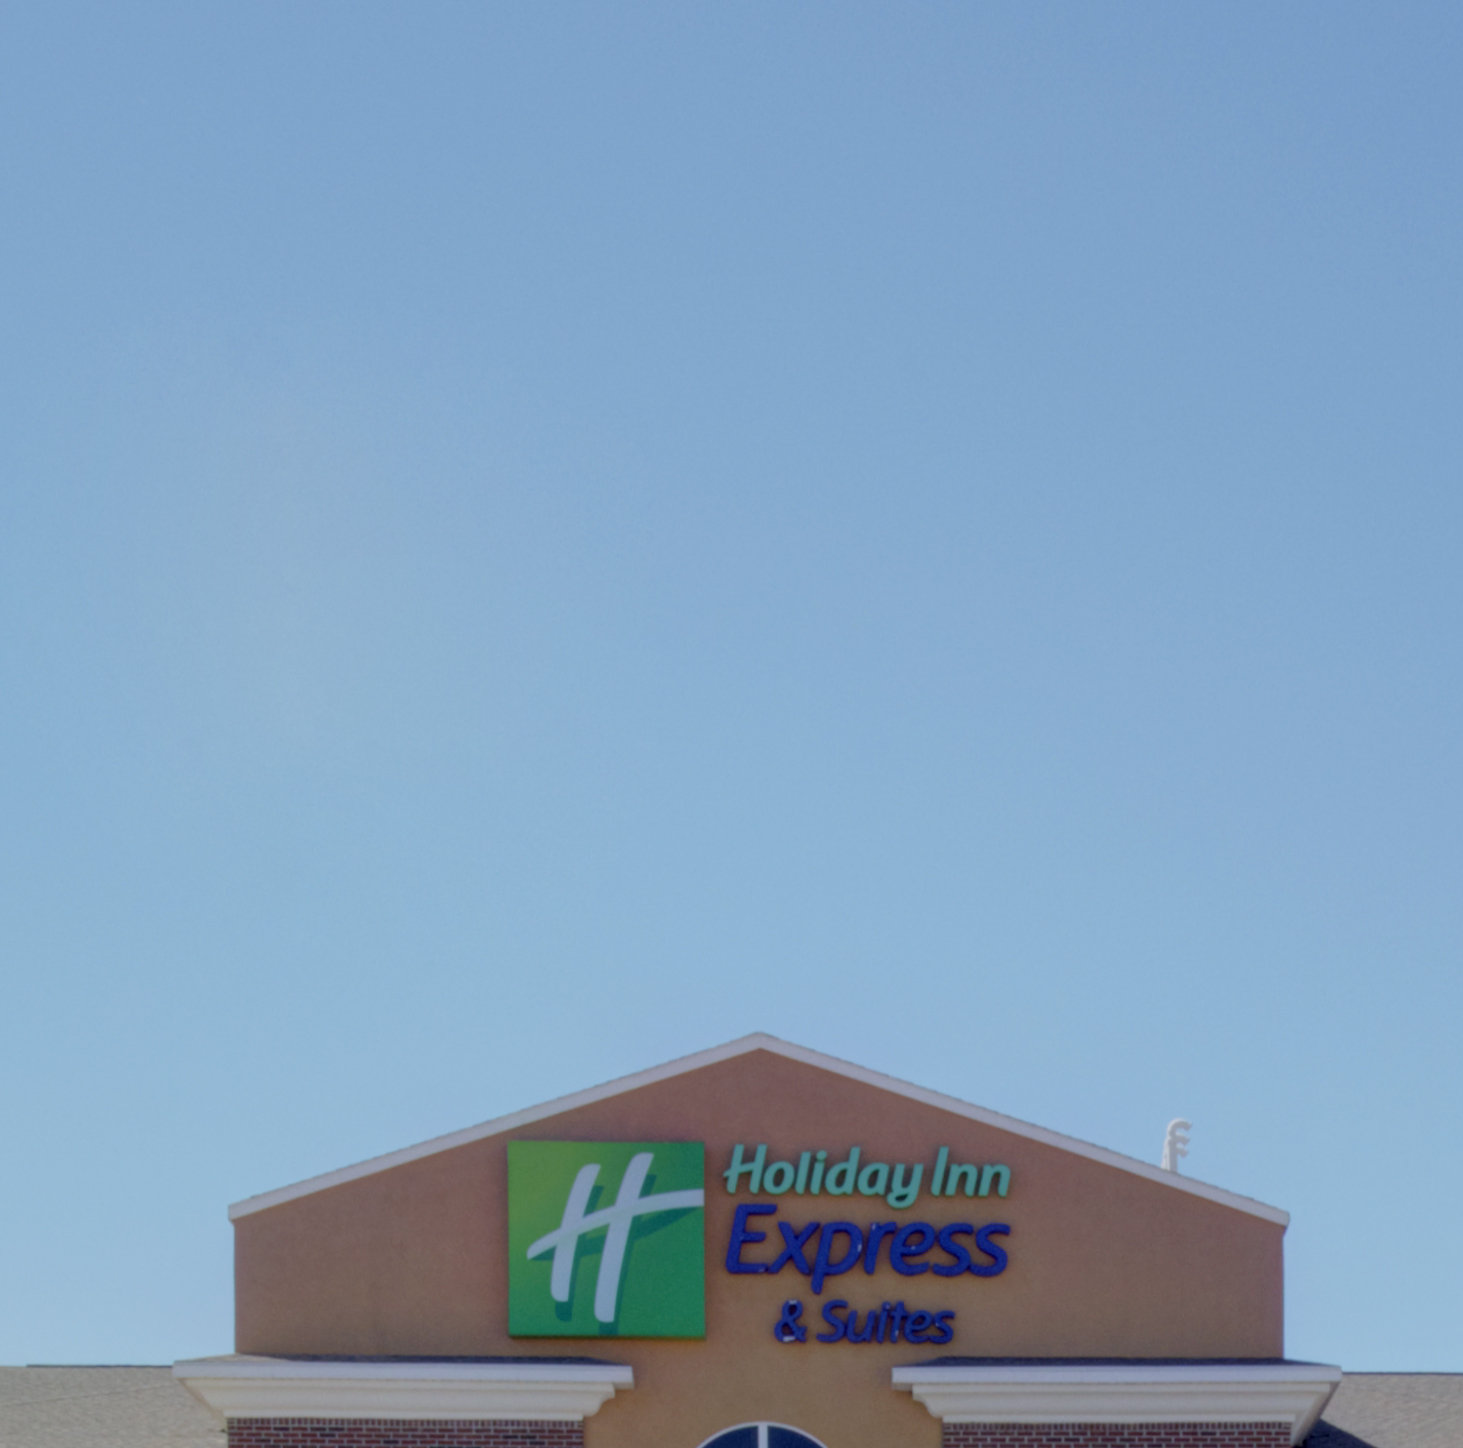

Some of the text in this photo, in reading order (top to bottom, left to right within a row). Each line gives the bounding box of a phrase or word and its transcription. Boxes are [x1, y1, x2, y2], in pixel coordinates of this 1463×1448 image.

[723, 1143, 1011, 1209] Holiday Inn
[725, 1203, 1011, 1295] Express
[774, 1299, 955, 1344] & Suites
